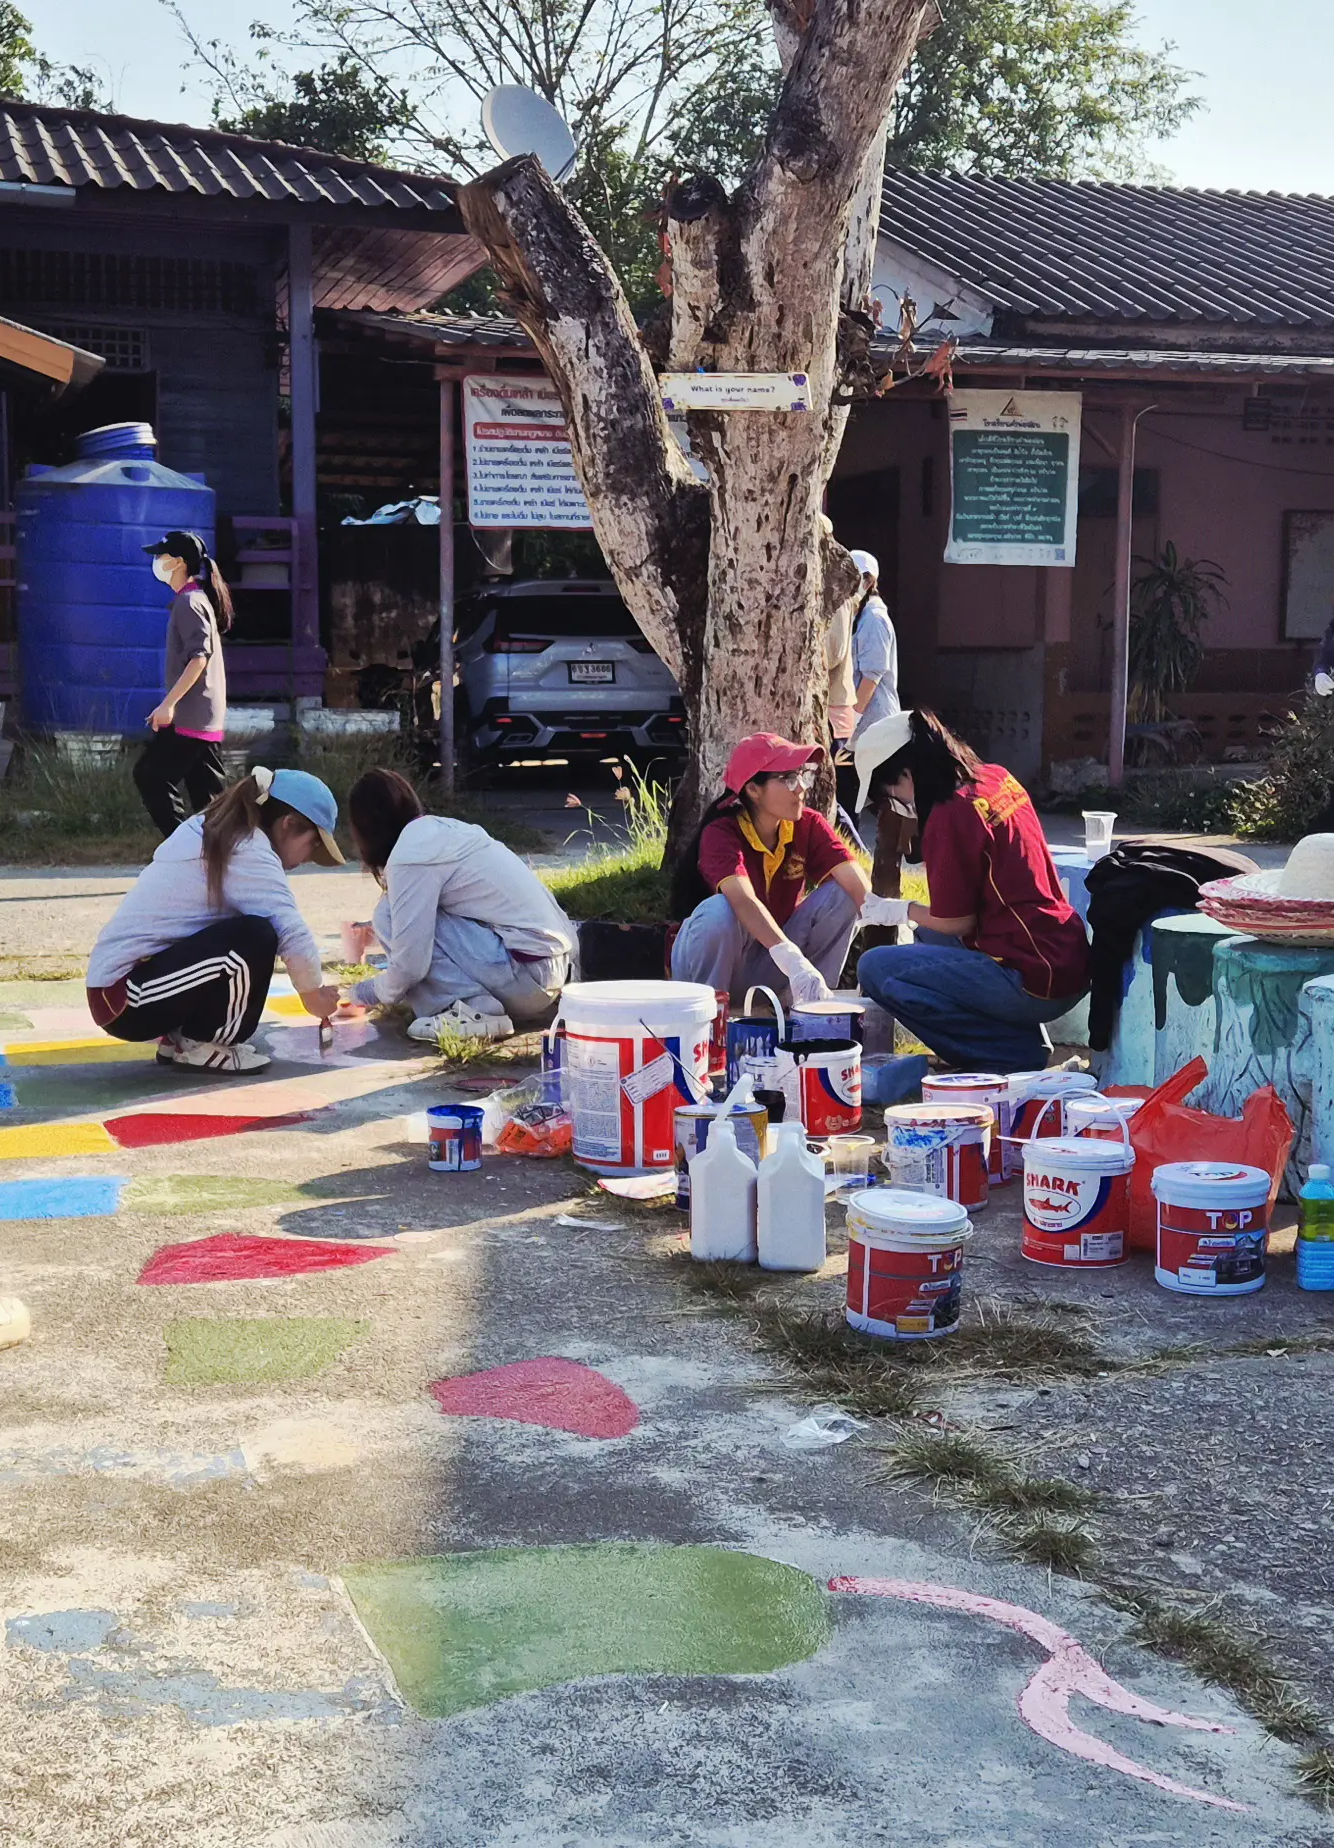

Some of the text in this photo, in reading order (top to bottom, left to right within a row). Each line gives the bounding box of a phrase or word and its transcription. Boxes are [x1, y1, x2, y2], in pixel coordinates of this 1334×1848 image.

[690, 385, 713, 393] What
[715, 385, 723, 393] is
[725, 386, 744, 394] your
[1026, 1172, 1081, 1197] SHARK
[1205, 1210, 1253, 1230] TOP
[927, 1248, 962, 1273] TOP
